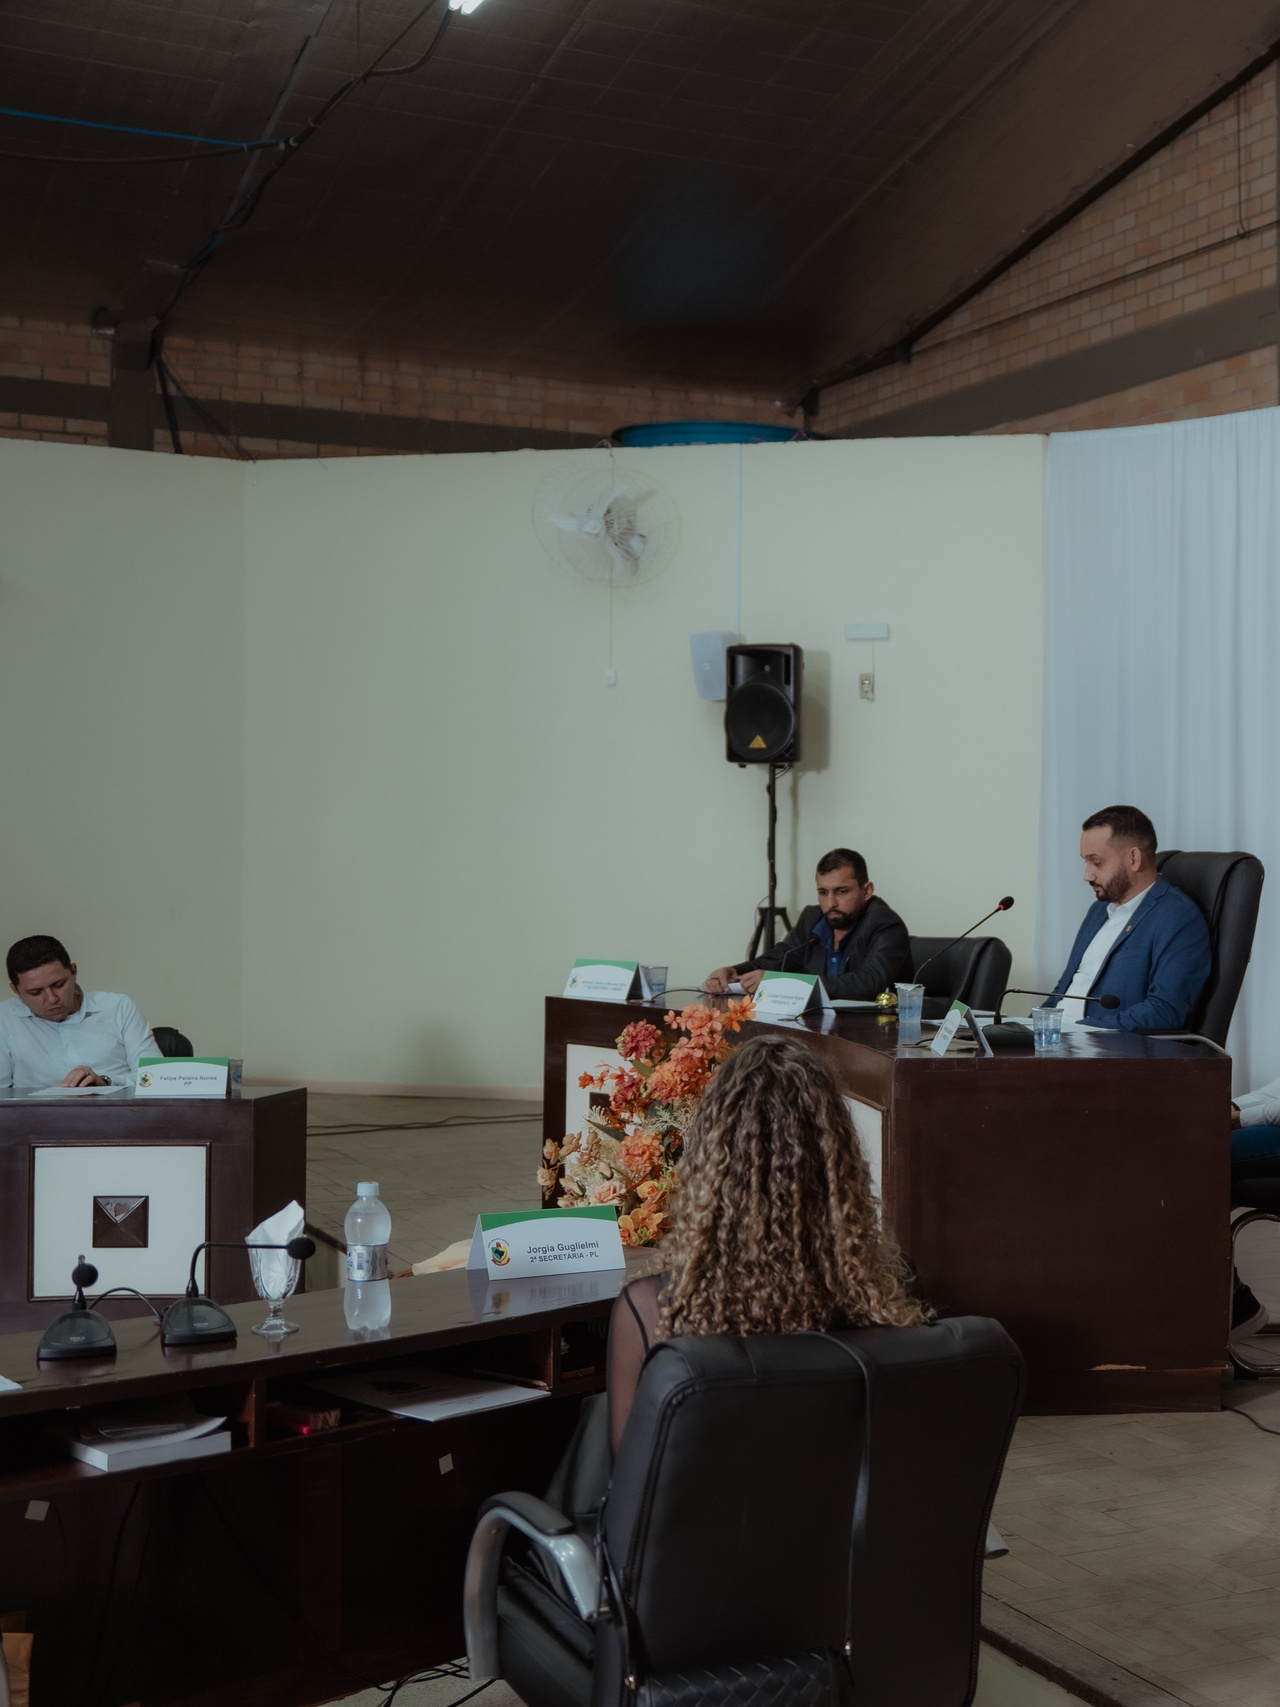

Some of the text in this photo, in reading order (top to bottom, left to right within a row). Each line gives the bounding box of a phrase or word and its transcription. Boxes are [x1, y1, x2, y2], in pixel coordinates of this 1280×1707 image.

[527, 1240, 599, 1255] Jorgia Guglielmi
[538, 1252, 585, 1262] SECRETÁRIA
